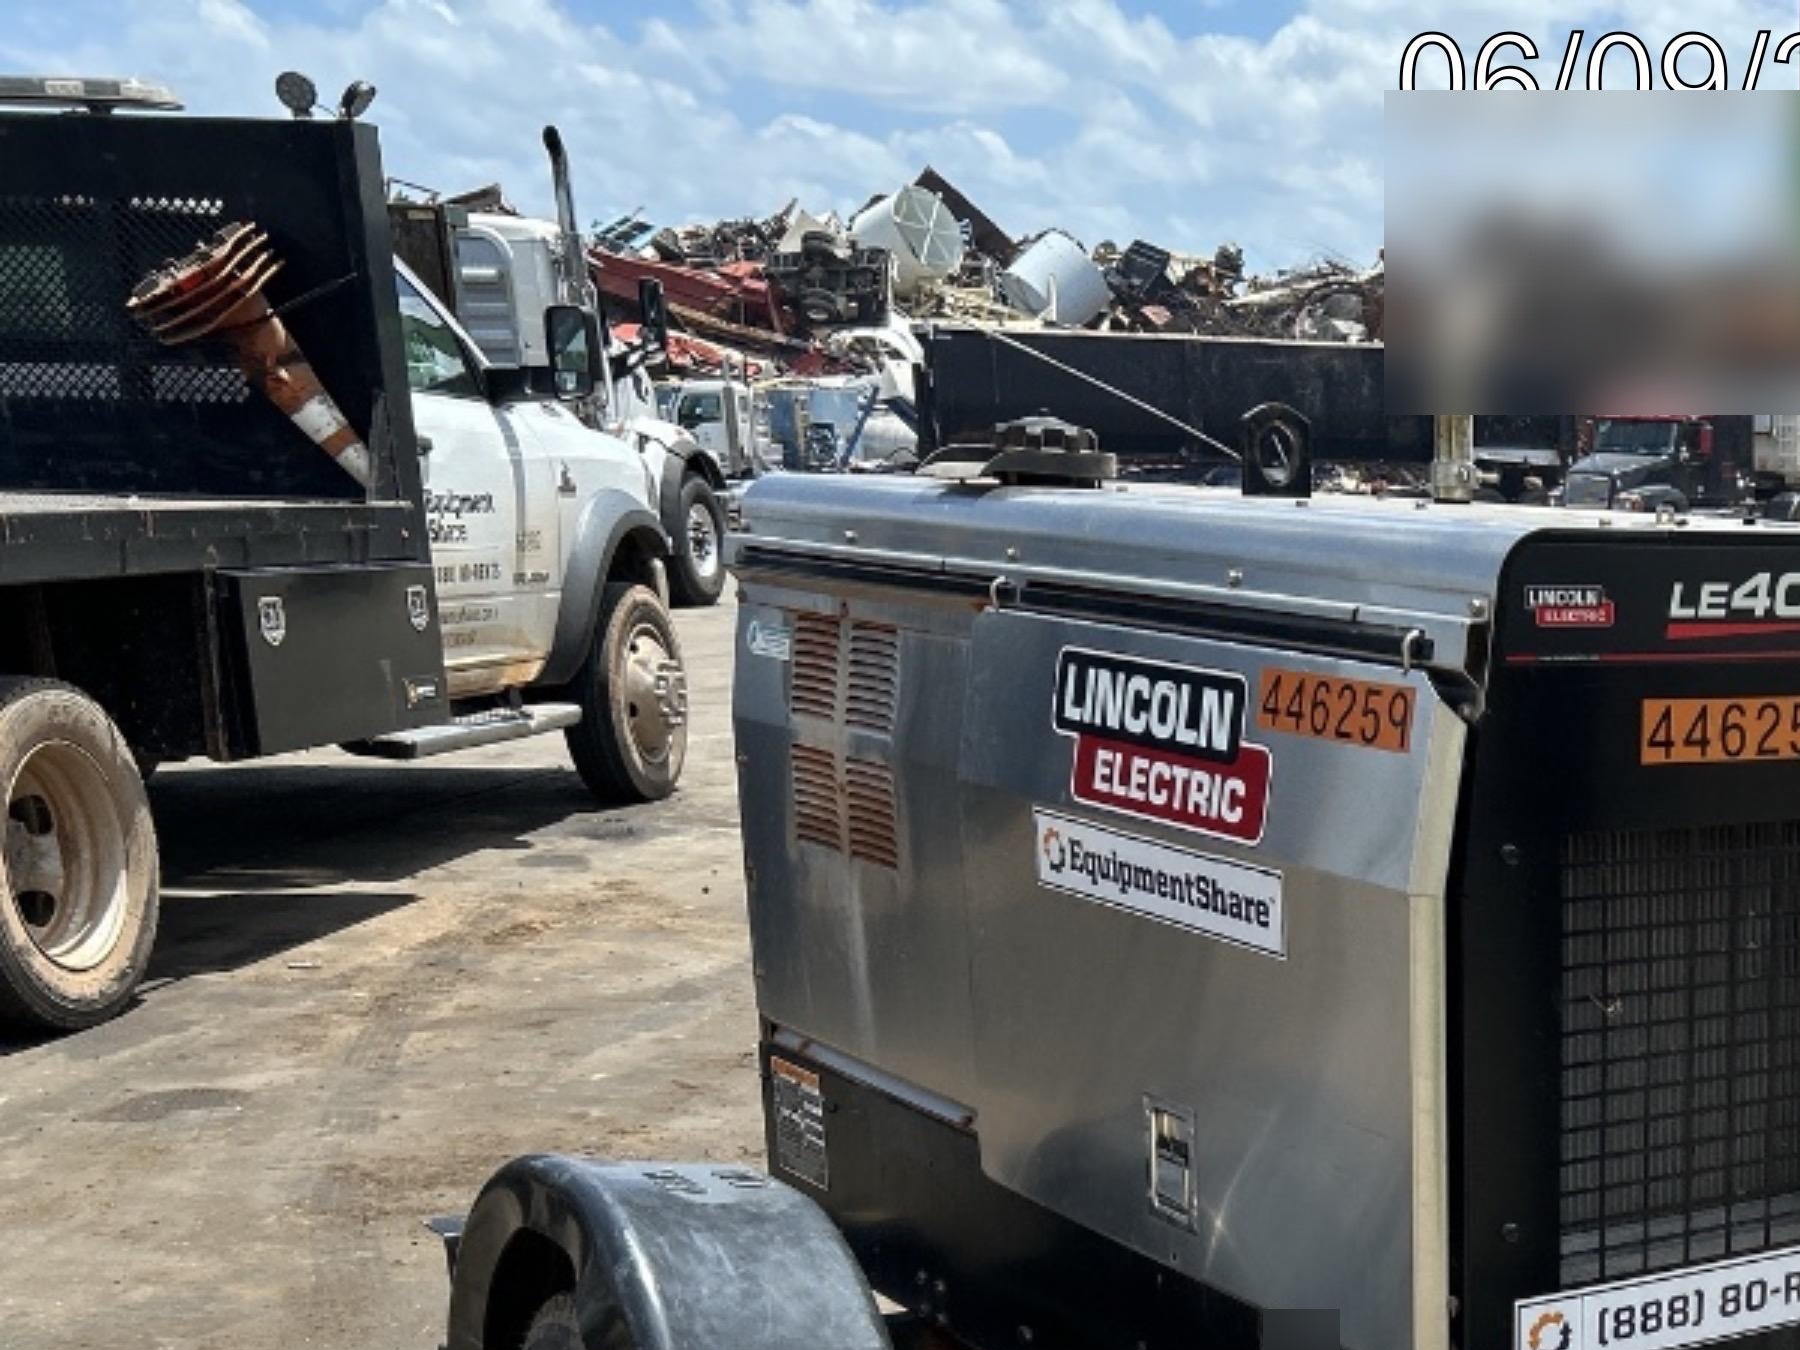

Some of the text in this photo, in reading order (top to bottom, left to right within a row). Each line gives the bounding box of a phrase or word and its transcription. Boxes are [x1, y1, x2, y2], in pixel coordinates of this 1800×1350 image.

[1529, 590, 1600, 607] LINCOLN
[1543, 608, 1606, 623] ELECTRIC
[1063, 662, 1234, 752] LINCOLN
[1261, 673, 1409, 750] 446259
[1091, 748, 1247, 824] ELECTRIC
[1067, 836, 1271, 929] EquipmentShare
[1598, 1290, 1705, 1346] (888)
